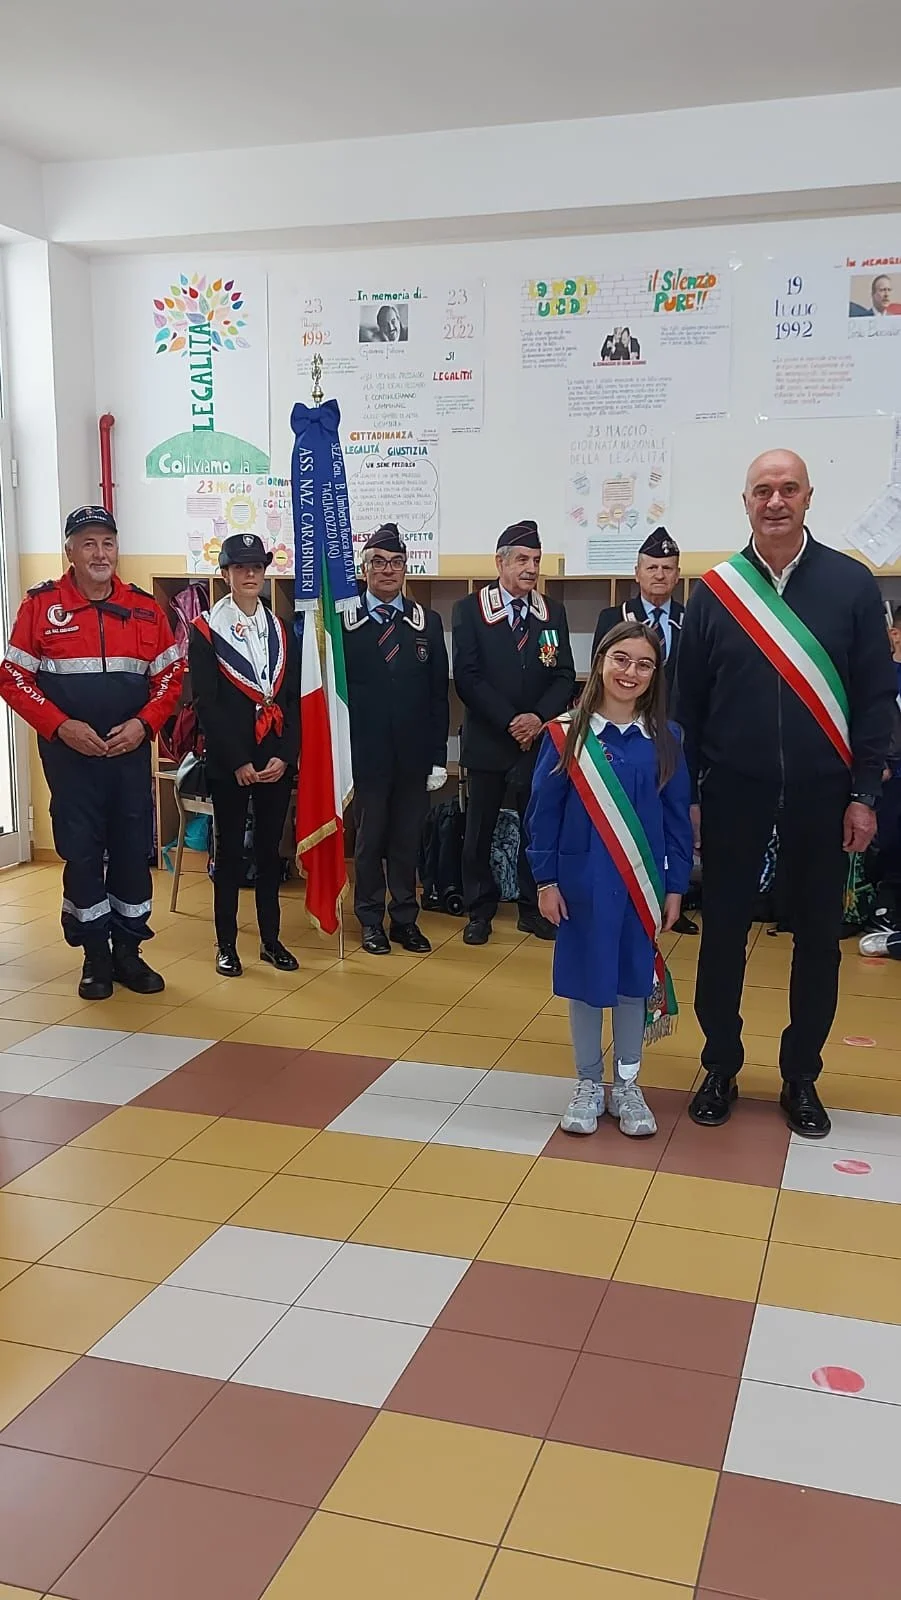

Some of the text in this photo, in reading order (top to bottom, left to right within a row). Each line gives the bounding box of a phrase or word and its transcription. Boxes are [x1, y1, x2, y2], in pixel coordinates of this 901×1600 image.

[787, 275, 802, 295] 19
[372, 289, 409, 300] memoria
[448, 289, 468, 305] 23
[304, 298, 322, 313] 23
[444, 323, 474, 339] 2022
[775, 321, 813, 340] 1992
[302, 331, 332, 347] 1992
[350, 431, 413, 441] CITTADINANZA
[586, 425, 600, 437] 23
[388, 446, 428, 456] GIUSTIZIA
[197, 480, 213, 493] 23
[299, 447, 314, 593] ASS. NAZ. CARABINIERI
[321, 481, 342, 559] TAGLIACOZZO (AQ)
